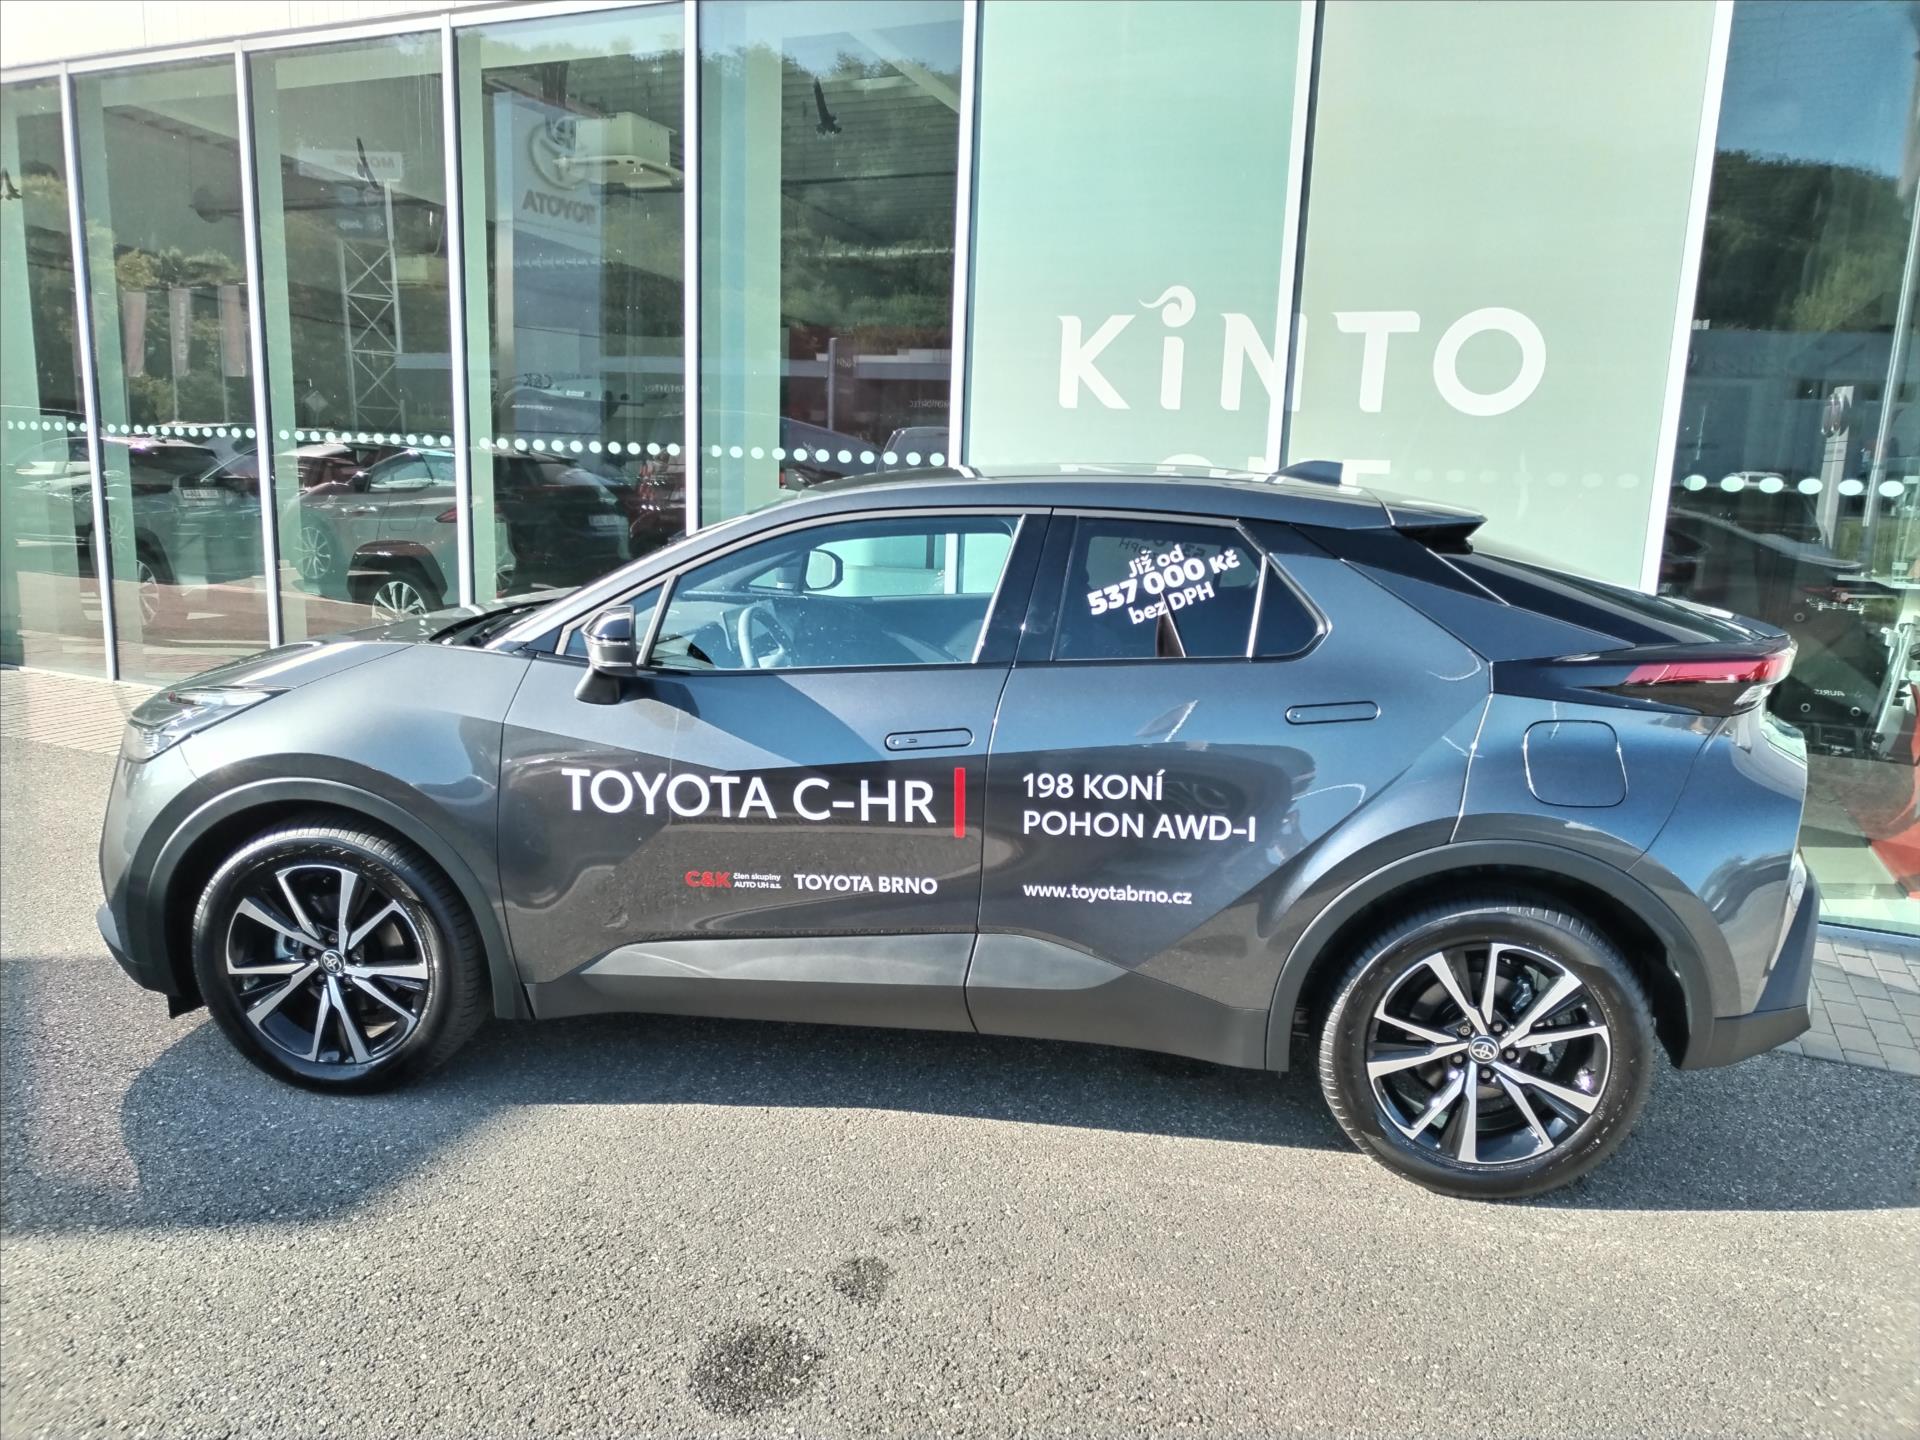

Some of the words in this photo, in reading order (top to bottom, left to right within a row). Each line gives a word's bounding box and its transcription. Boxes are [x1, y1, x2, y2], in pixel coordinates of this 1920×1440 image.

[1128, 549, 1156, 578] Již
[1156, 543, 1185, 567] od
[1086, 578, 1138, 616] 537
[1143, 557, 1206, 595] 000
[1208, 548, 1241, 575] Kč
[1127, 600, 1169, 625] bez
[1167, 580, 1216, 612] DPH
[561, 767, 778, 819] TOYOTA
[792, 776, 937, 824] C-HR
[1022, 772, 1075, 799] 198
[1083, 768, 1166, 801] KONÍ
[1023, 810, 1144, 839] POHON
[1152, 813, 1257, 843] AWD-I
[684, 870, 732, 889] C&K
[751, 873, 781, 882] skupiny
[794, 873, 874, 892] TOYOTA
[878, 876, 938, 895] BRNO
[1023, 884, 1193, 905] www.toyotabrno.cz
